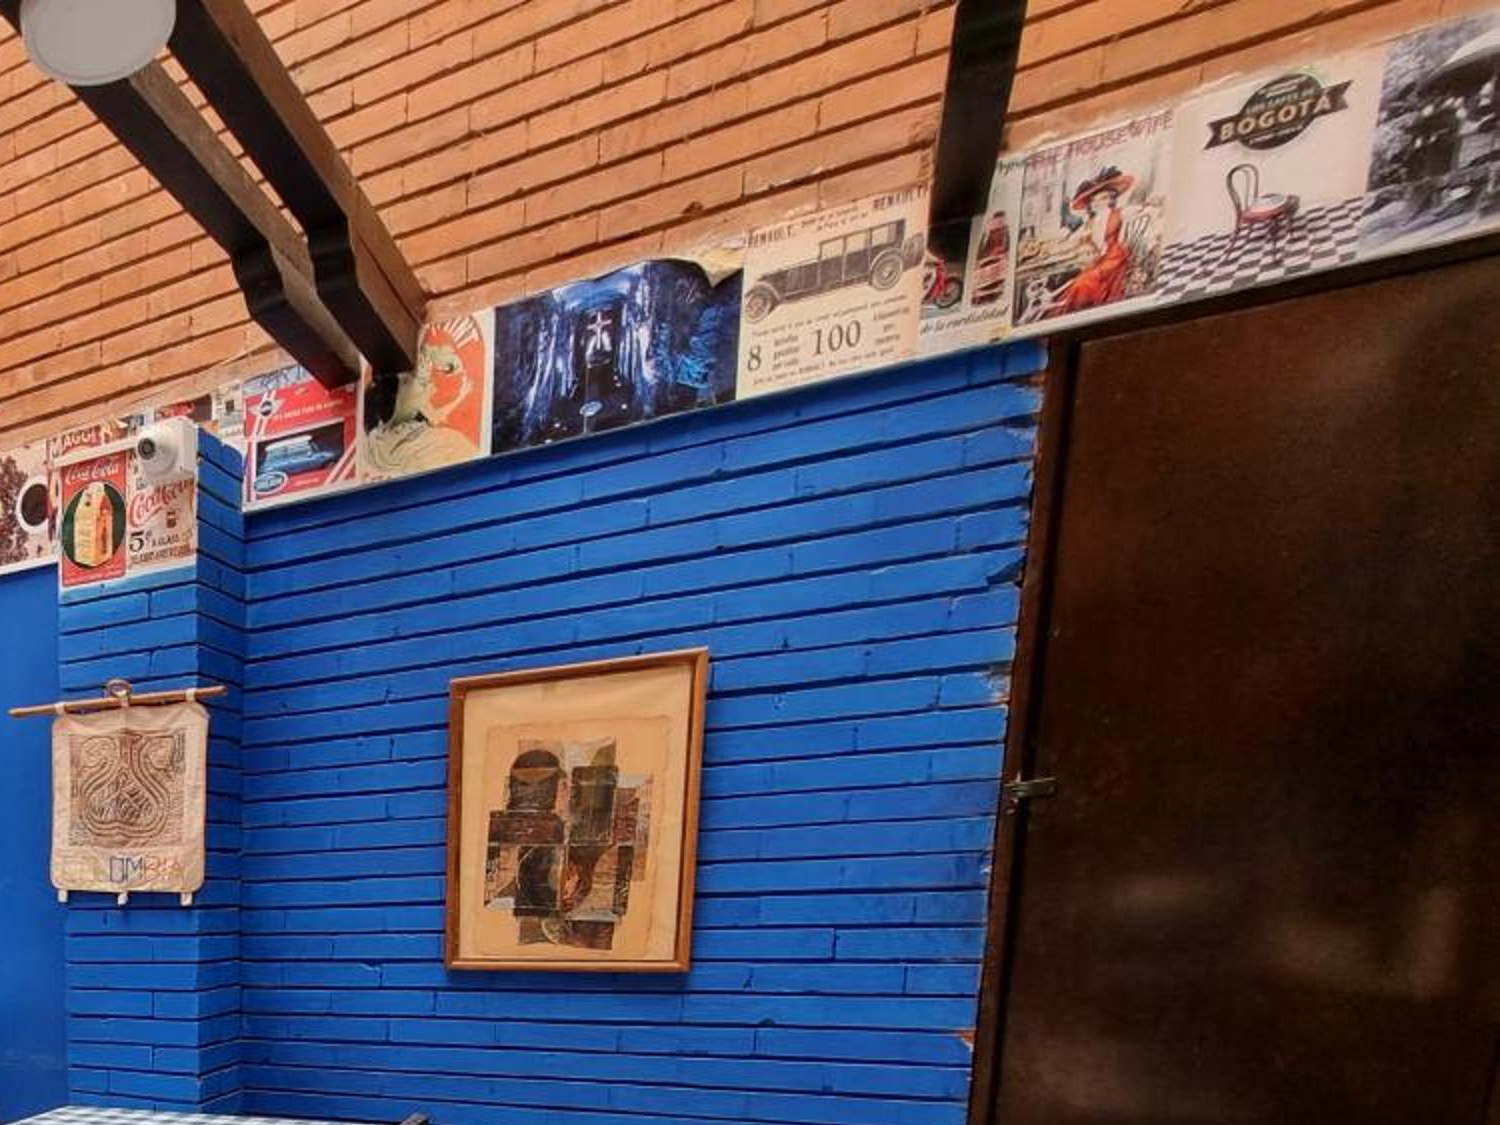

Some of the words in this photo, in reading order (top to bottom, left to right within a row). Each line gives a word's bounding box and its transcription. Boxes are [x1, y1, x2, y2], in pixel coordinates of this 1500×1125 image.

[746, 344, 762, 372] 8
[812, 319, 862, 356] 100
[51, 427, 98, 458] MAGGI
